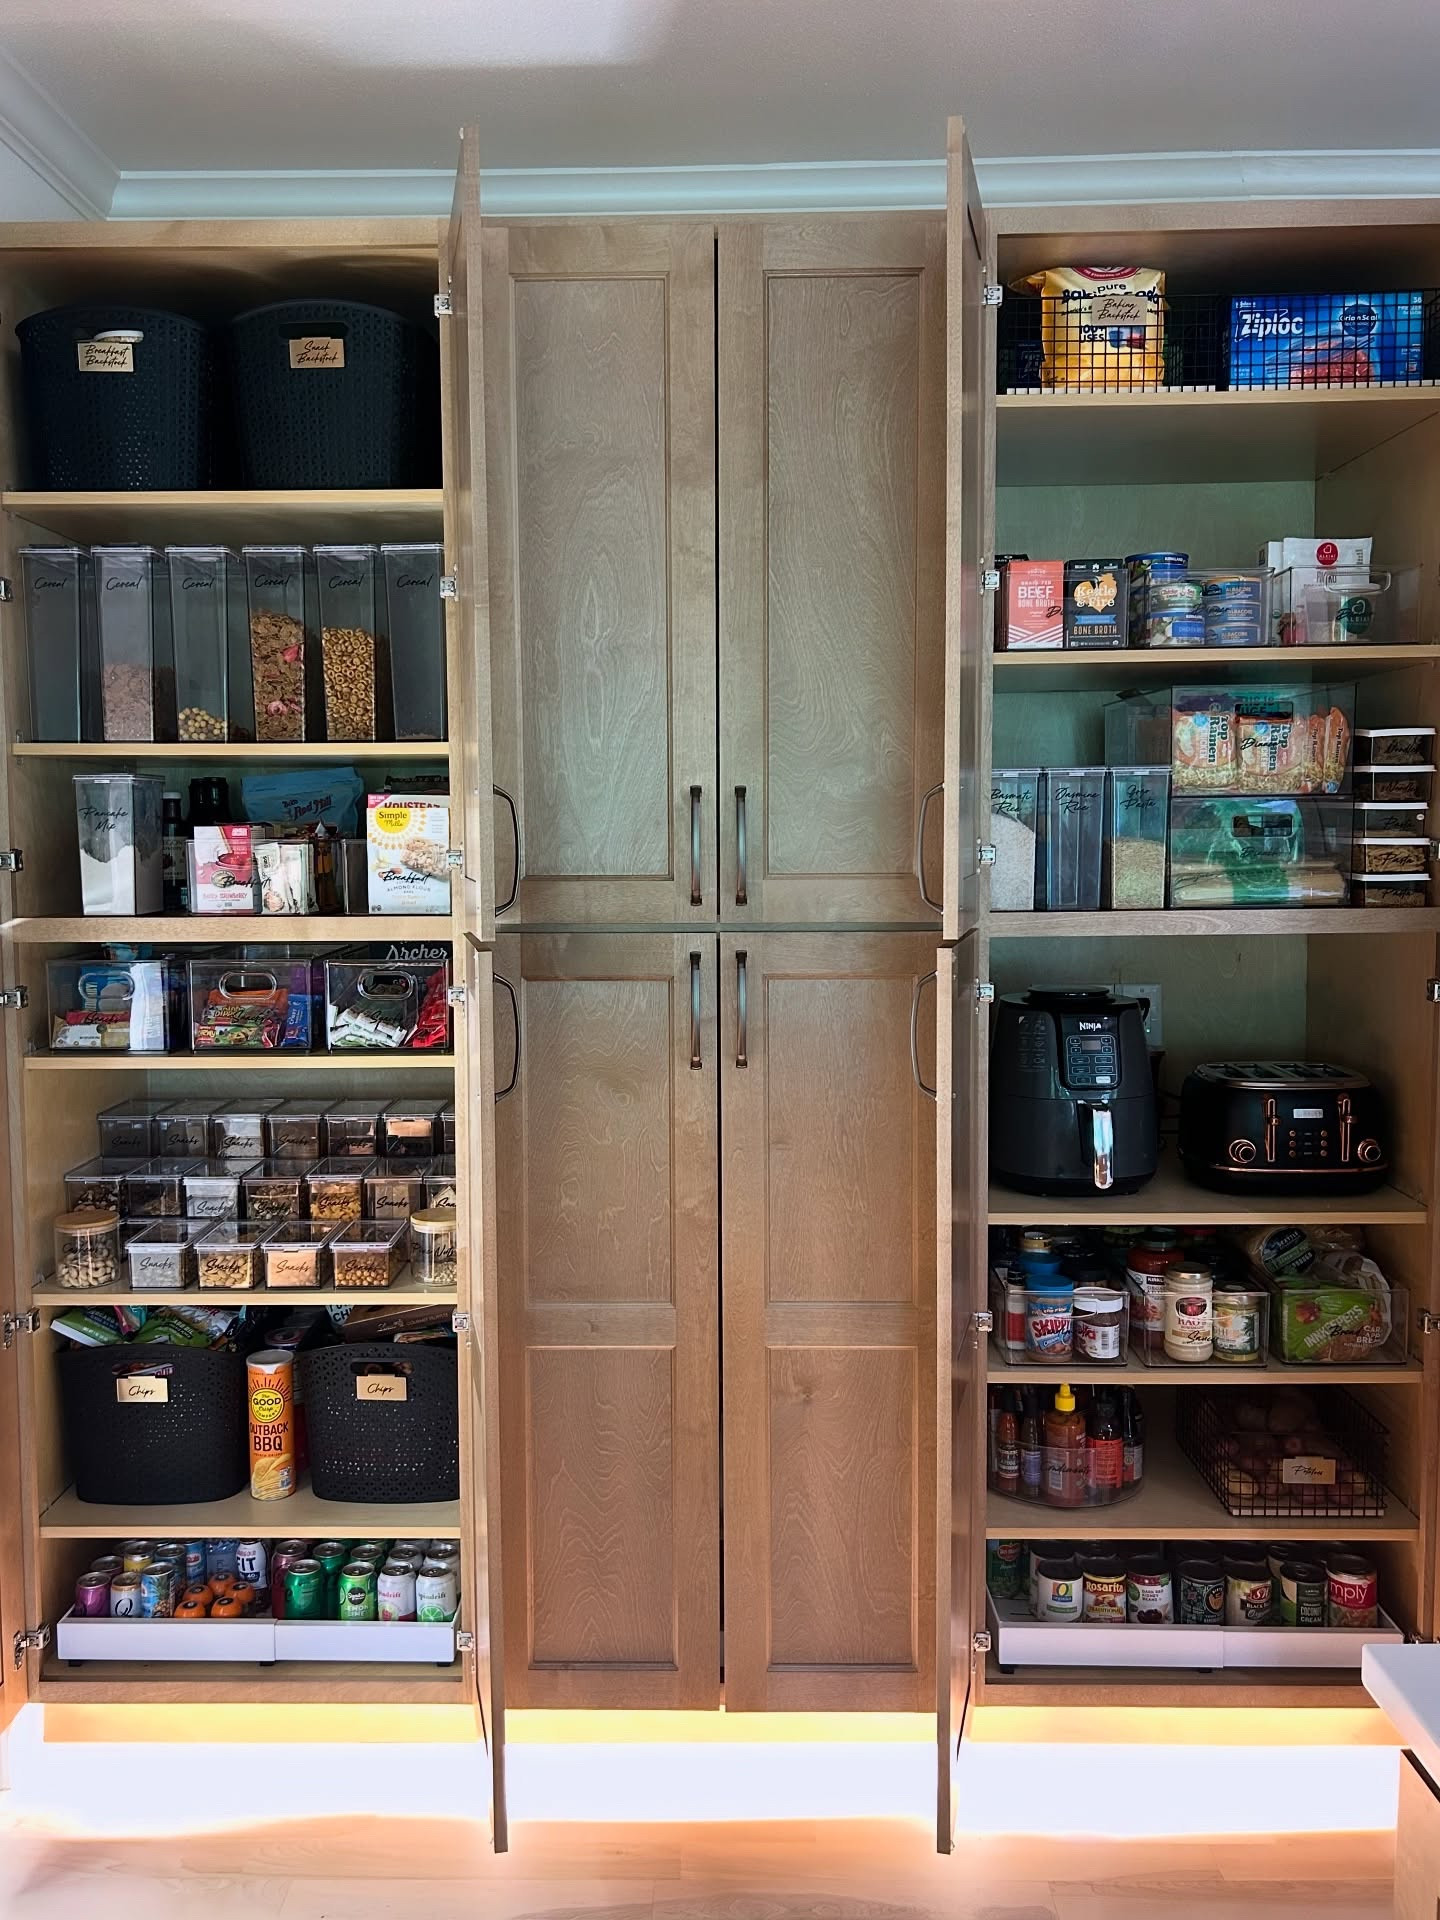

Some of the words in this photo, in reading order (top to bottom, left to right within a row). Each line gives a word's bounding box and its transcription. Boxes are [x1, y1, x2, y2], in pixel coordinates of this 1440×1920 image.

[1097, 283, 1127, 293] pure
[1102, 299, 1137, 312] Baking
[1096, 310, 1141, 322] Backstock
[1240, 313, 1304, 342] Ziploc
[83, 345, 131, 357] Breakfast
[303, 340, 331, 353] Snack
[84, 355, 128, 368] Backstock
[296, 351, 339, 365] Backstock
[34, 576, 68, 590] Cereal
[106, 576, 143, 590] Cereal
[182, 577, 215, 590] Cereal
[254, 574, 292, 588] Cereal
[328, 574, 364, 589] Cereal
[396, 575, 434, 588] Cereal
[1017, 585, 1055, 599] BEEF
[1076, 584, 1115, 595] Kettle
[1087, 597, 1115, 607] Fire
[1073, 625, 1092, 635] BONE
[1094, 624, 1117, 635] BROTH
[1217, 715, 1229, 741] Top
[1335, 727, 1343, 739] Top
[1208, 716, 1220, 764] Ramen
[1279, 724, 1292, 748] Top
[1268, 725, 1281, 772] Ramen
[991, 788, 1032, 800] Basmati
[1055, 787, 1100, 801] Jasmine
[992, 800, 1022, 814] Rice
[1059, 800, 1090, 813] Rice
[1120, 799, 1156, 810] Pasta
[80, 806, 129, 819] Pancake
[378, 811, 408, 821] Simple
[95, 818, 117, 832] Mix
[1377, 815, 1415, 829] Pasta
[1378, 851, 1415, 866] Pasta
[381, 870, 433, 885] Breakfast
[383, 943, 448, 962] Archer
[1079, 1021, 1102, 1032] NINJA
[168, 1133, 200, 1146] Snacks
[222, 1135, 254, 1149] Snacks
[278, 1134, 310, 1146] Snacks
[197, 1200, 229, 1214] Snacks
[319, 1197, 352, 1210] Snacks
[376, 1196, 409, 1209] Snacks
[139, 1257, 174, 1271] Snacks
[206, 1258, 240, 1273] Snacks
[276, 1259, 311, 1274] Snacks
[344, 1259, 378, 1273] Snacks
[1032, 1318, 1072, 1339] SKIPPY
[128, 1384, 156, 1398] Chips
[367, 1382, 395, 1396] Chips
[252, 1397, 282, 1405] GOOD
[254, 1435, 283, 1451] BBQ
[1085, 1581, 1125, 1593] Rosarita
[114, 1598, 134, 1617] Q
[1300, 1607, 1322, 1617] COCONUT
